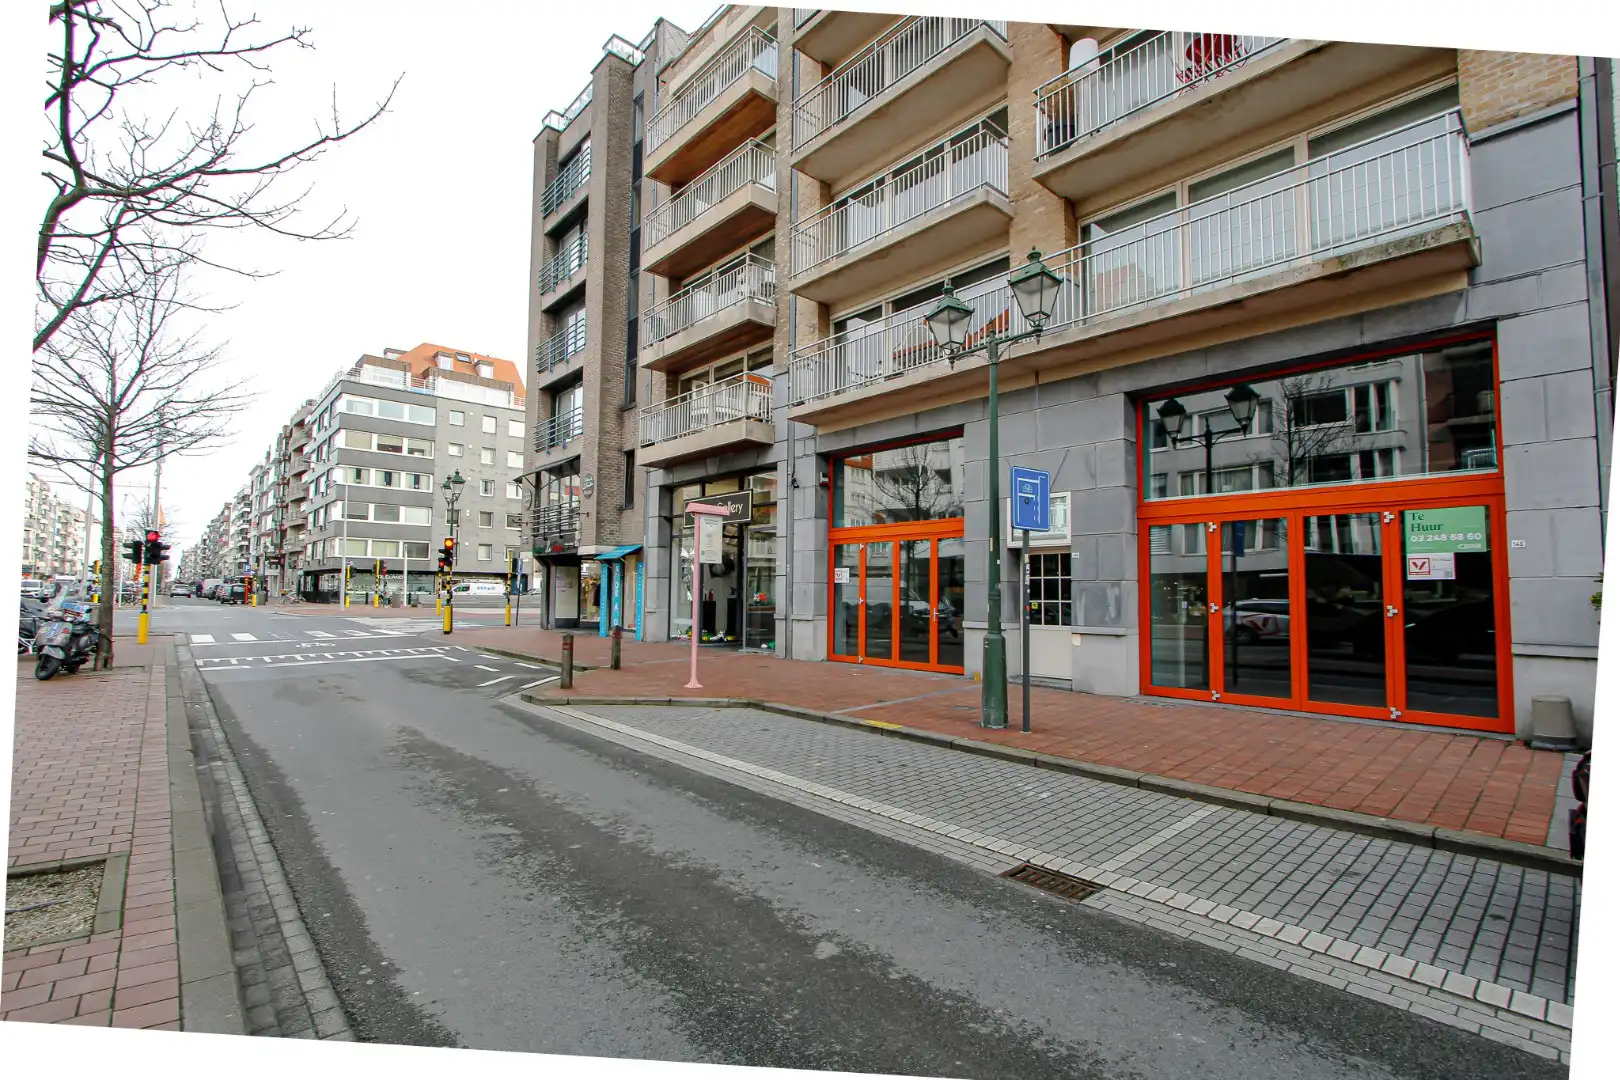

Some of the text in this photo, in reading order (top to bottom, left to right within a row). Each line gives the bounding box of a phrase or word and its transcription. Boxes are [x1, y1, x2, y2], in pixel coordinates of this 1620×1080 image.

[1409, 512, 1424, 521] Te
[1411, 522, 1443, 532] Huur
[1411, 534, 1424, 543] 03
